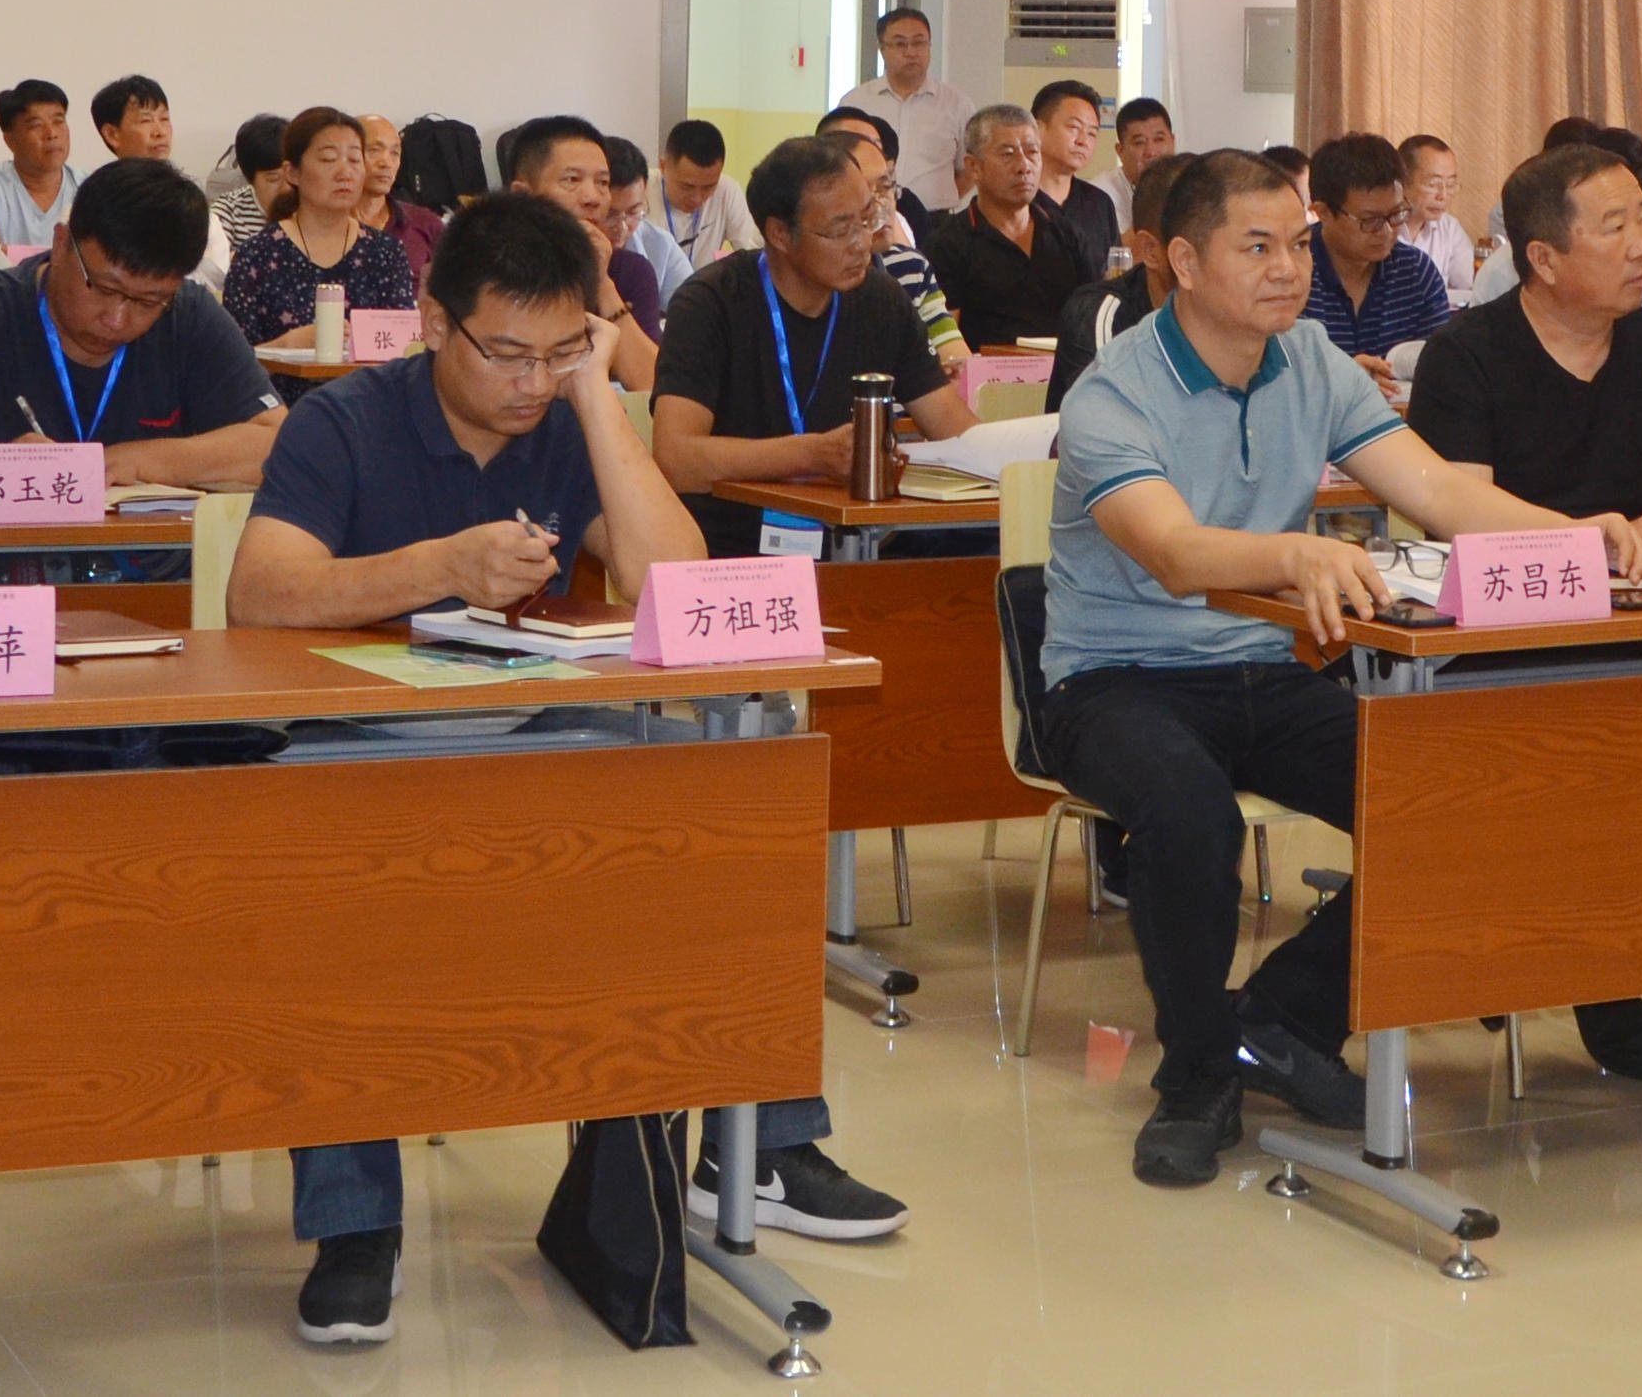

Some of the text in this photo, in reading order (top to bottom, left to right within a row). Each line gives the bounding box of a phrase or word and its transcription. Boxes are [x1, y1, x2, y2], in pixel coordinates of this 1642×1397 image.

[1483, 559, 1587, 602] 苏昌东
[684, 595, 800, 637] 方祖强
